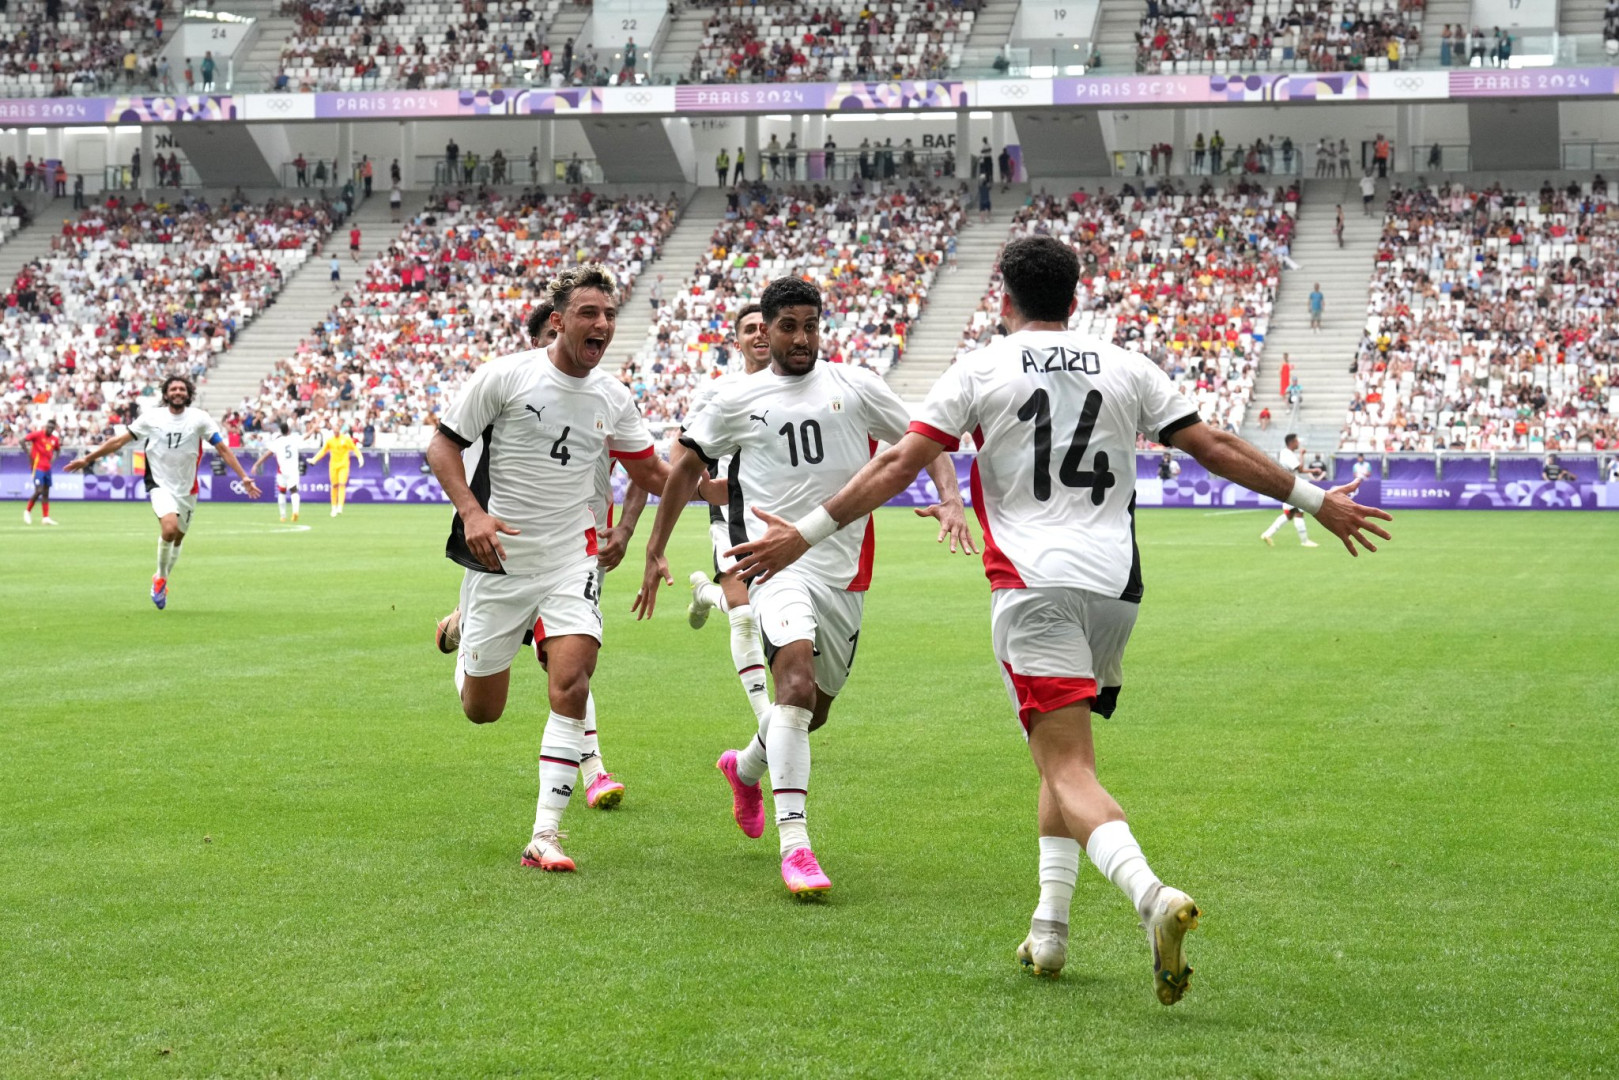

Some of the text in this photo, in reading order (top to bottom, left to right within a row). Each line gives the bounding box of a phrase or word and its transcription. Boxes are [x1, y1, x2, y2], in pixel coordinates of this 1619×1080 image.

[1054, 9, 1067, 20] 19
[622, 19, 637, 30] 22
[211, 28, 226, 39] 24
[1474, 75, 1589, 90] PARIS 2024
[698, 90, 804, 104] PARIS 2024
[1077, 83, 1131, 97] PARIS
[42, 103, 86, 116] 2024
[336, 97, 438, 111] PARIS 2024
[1022, 346, 1101, 375] A.ZIZO
[166, 432, 182, 449] 17
[550, 426, 571, 466] 4
[779, 419, 824, 467] 10
[1017, 388, 1115, 506] 14
[285, 446, 292, 459] 5
[310, 483, 331, 492] 202
[1386, 488, 1450, 498] PARIS 2024
